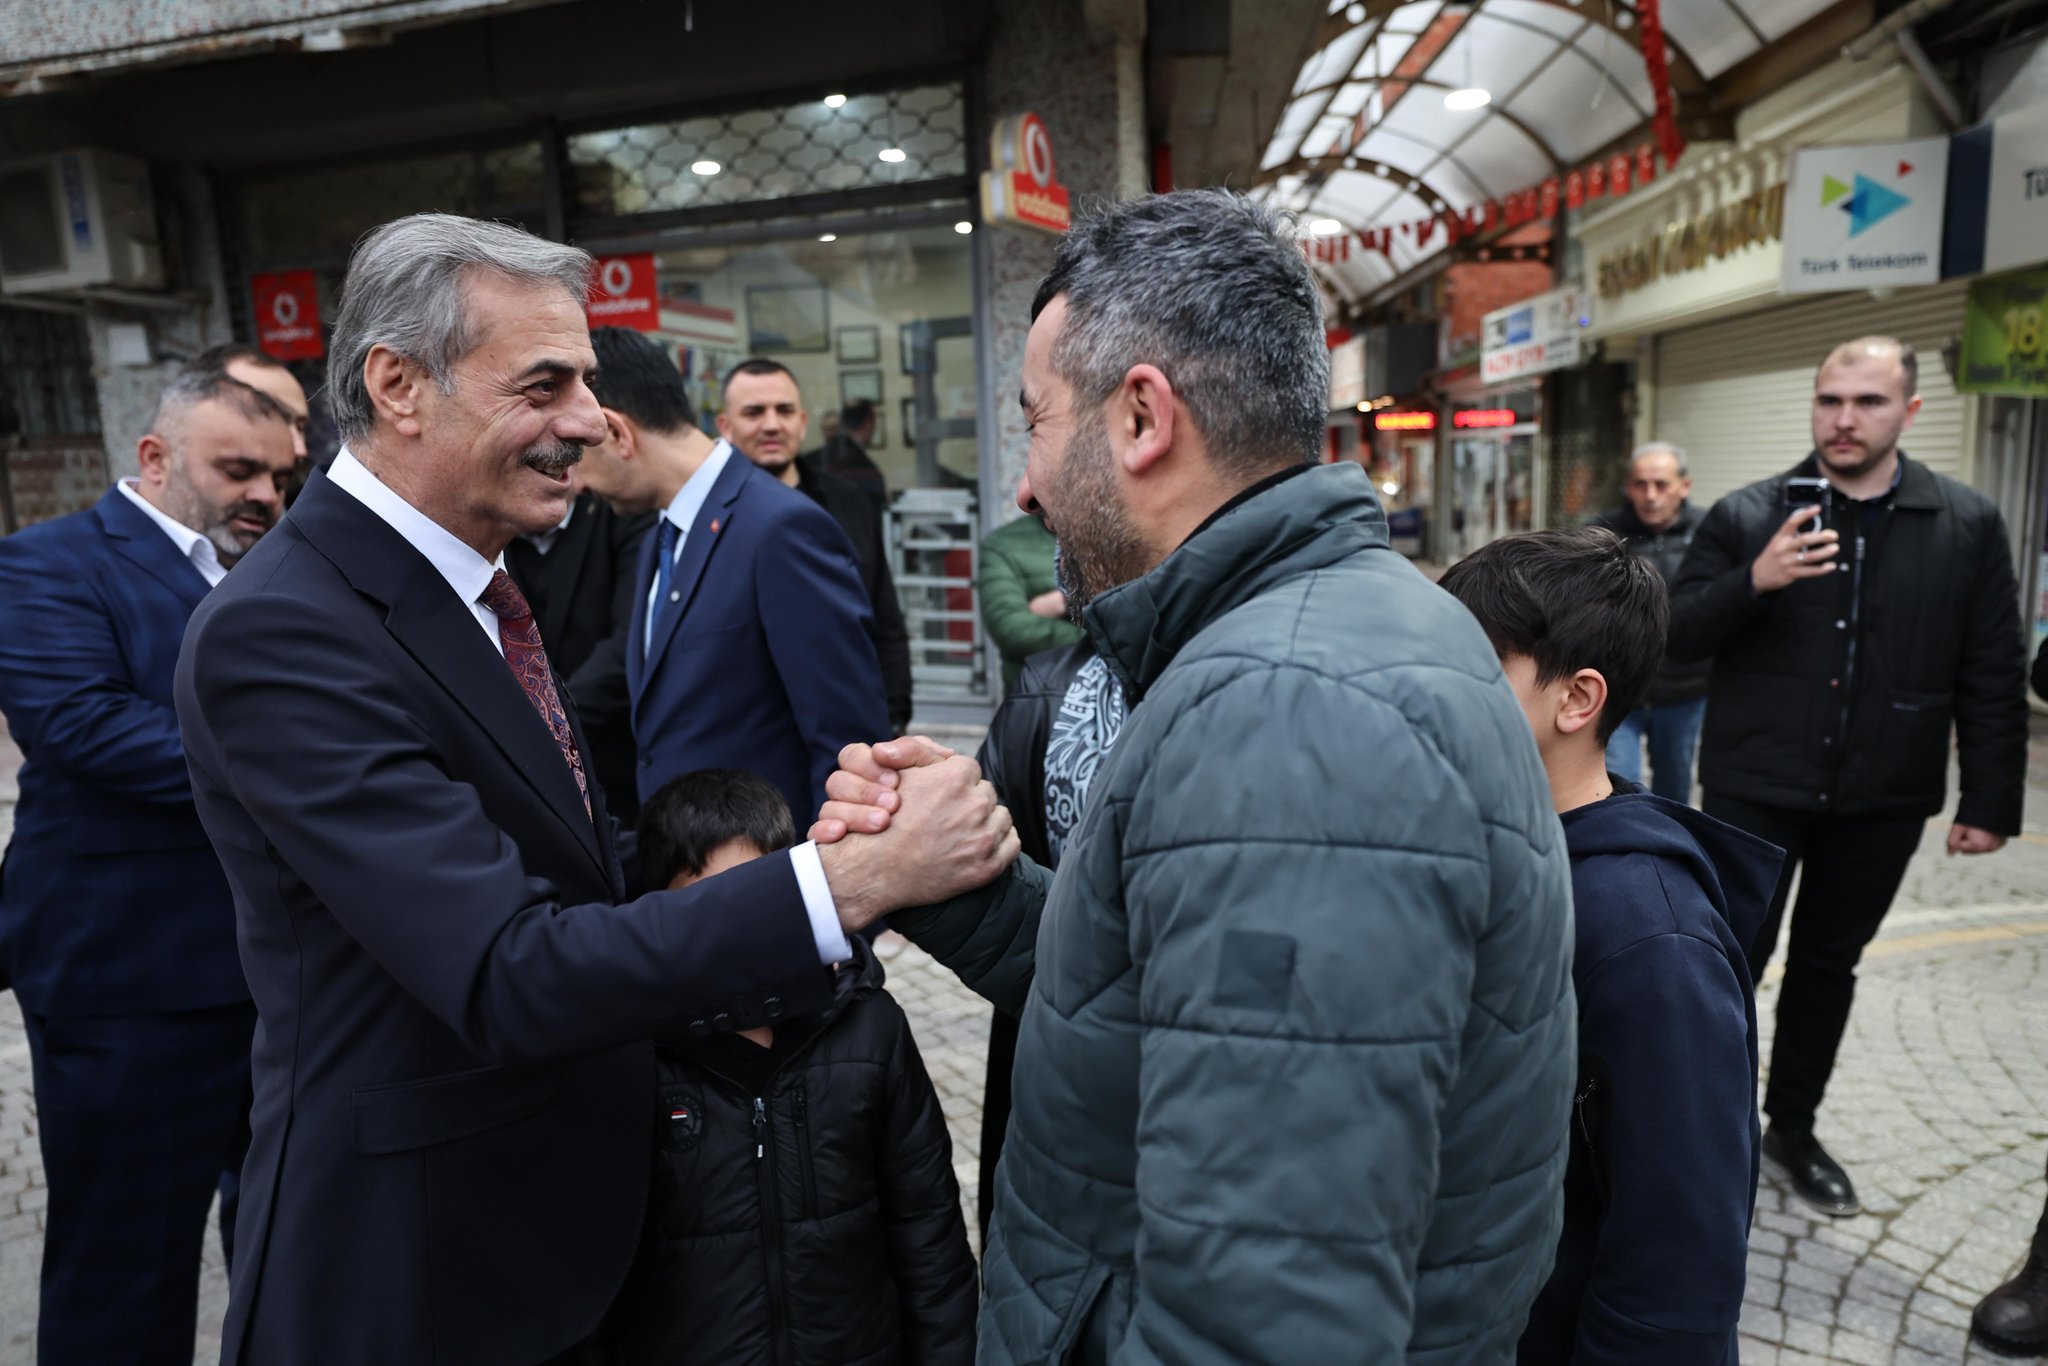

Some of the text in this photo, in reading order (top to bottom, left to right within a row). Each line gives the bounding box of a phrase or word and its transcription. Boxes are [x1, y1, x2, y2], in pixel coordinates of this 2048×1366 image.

[1014, 191, 1069, 223] vodafone
[1801, 253, 1928, 274] Türk Telekom
